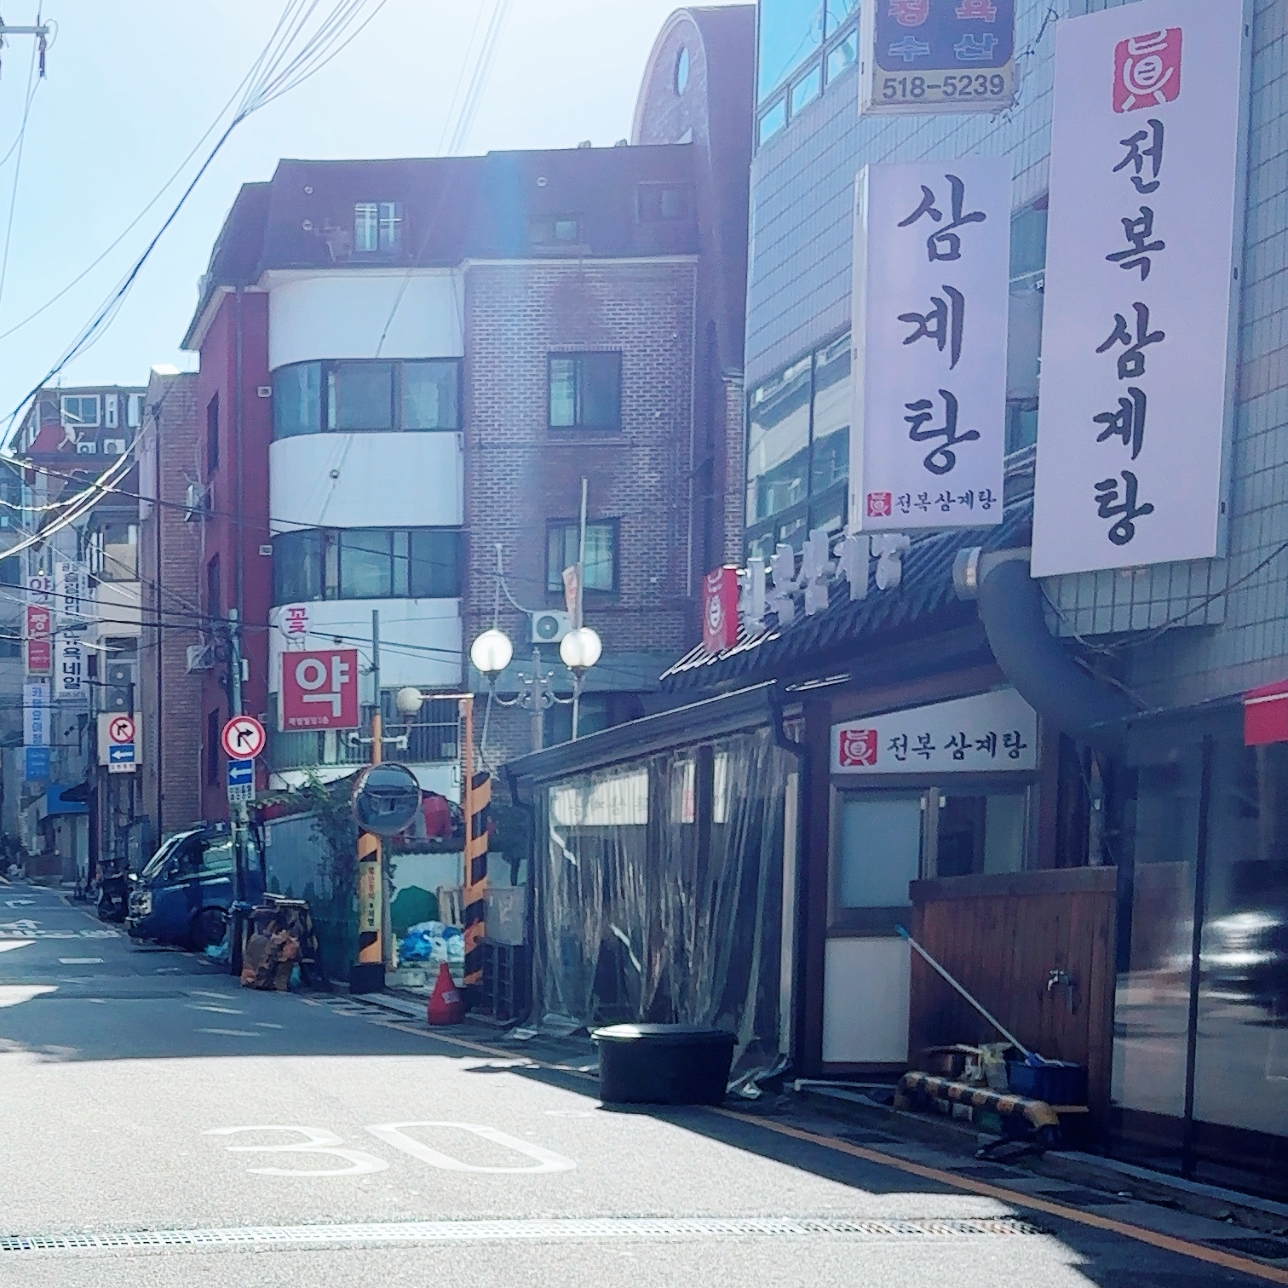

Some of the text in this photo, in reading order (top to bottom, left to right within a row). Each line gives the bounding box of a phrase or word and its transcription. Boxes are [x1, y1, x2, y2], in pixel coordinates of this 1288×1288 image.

[888, 33, 999, 62] 수산
[882, 74, 1005, 99] 518-5239
[897, 174, 987, 476] 삼계탕
[285, 607, 309, 634] 꽃
[295, 655, 350, 718] 약
[200, 1120, 578, 1178] 30
